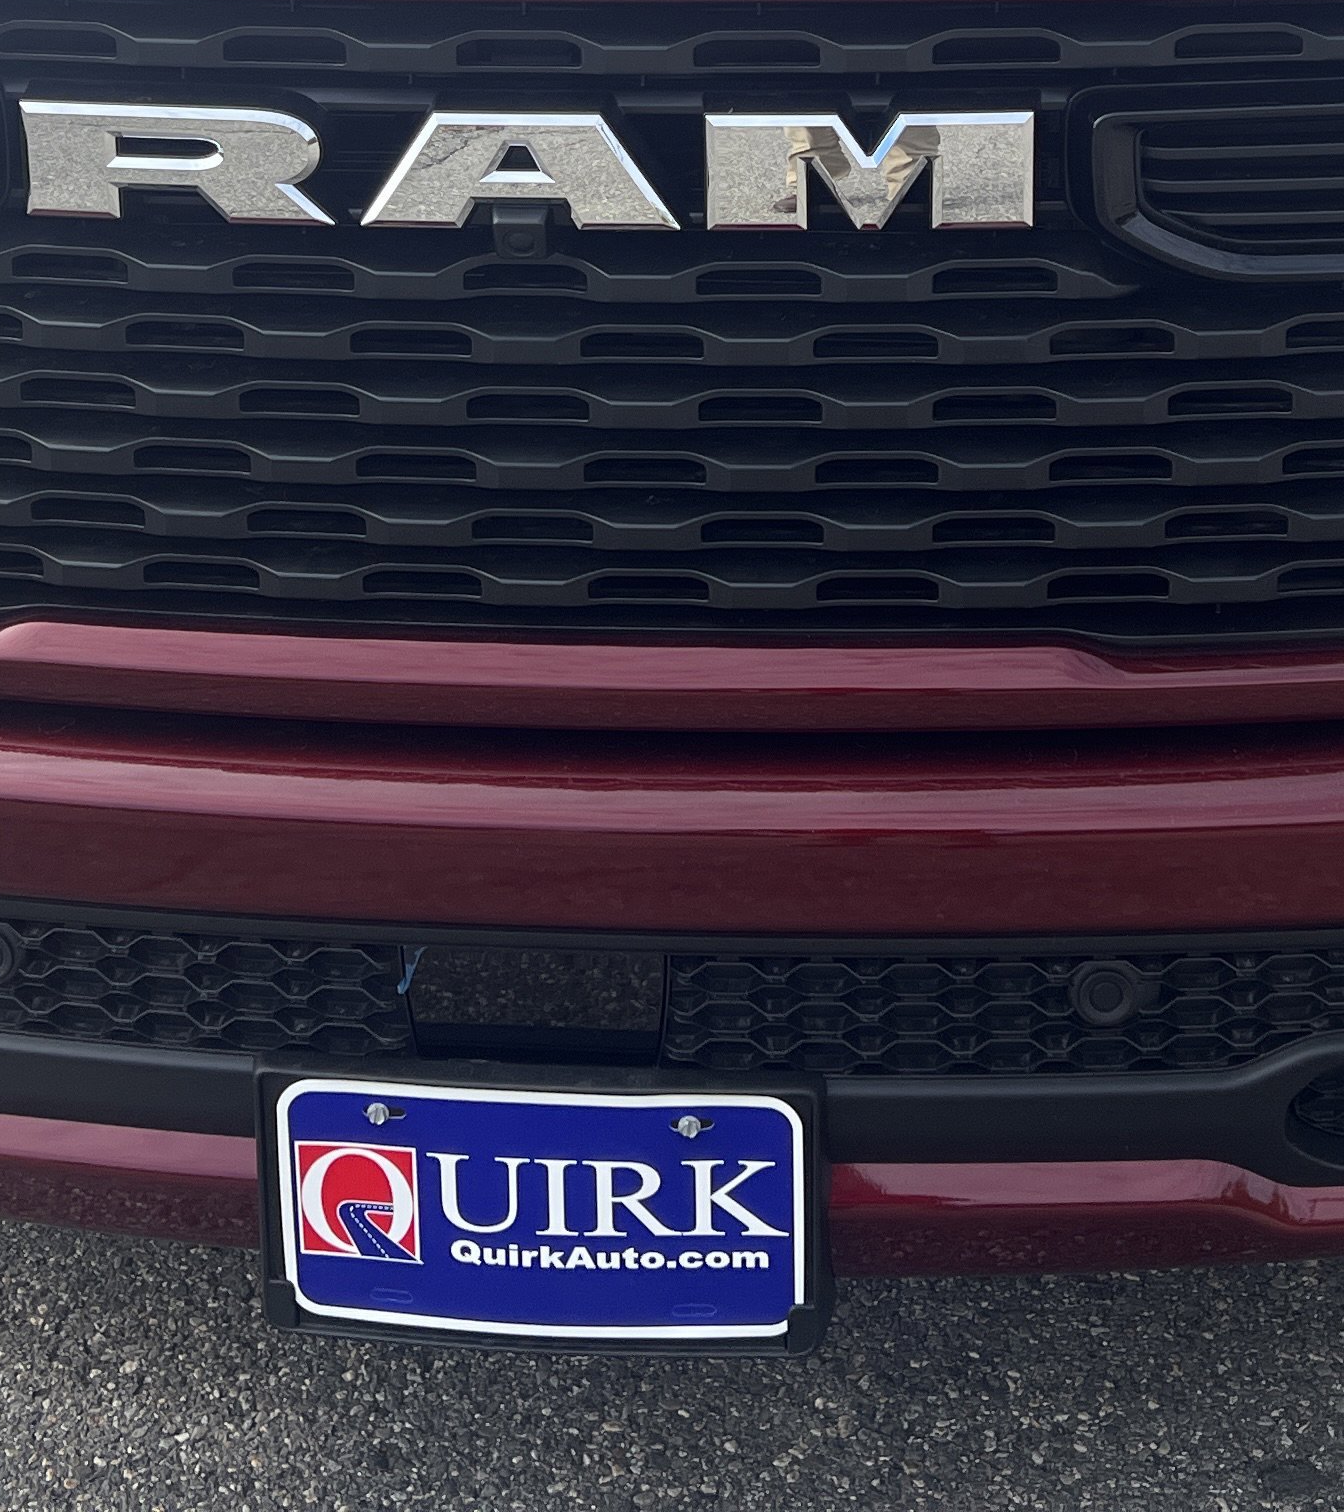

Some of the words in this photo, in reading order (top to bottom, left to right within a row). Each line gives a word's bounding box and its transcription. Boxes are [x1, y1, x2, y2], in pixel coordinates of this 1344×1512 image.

[19, 99, 1035, 231] RAM
[300, 1145, 790, 1263] QUIRK
[449, 1237, 770, 1271] QuirkAuto.com
